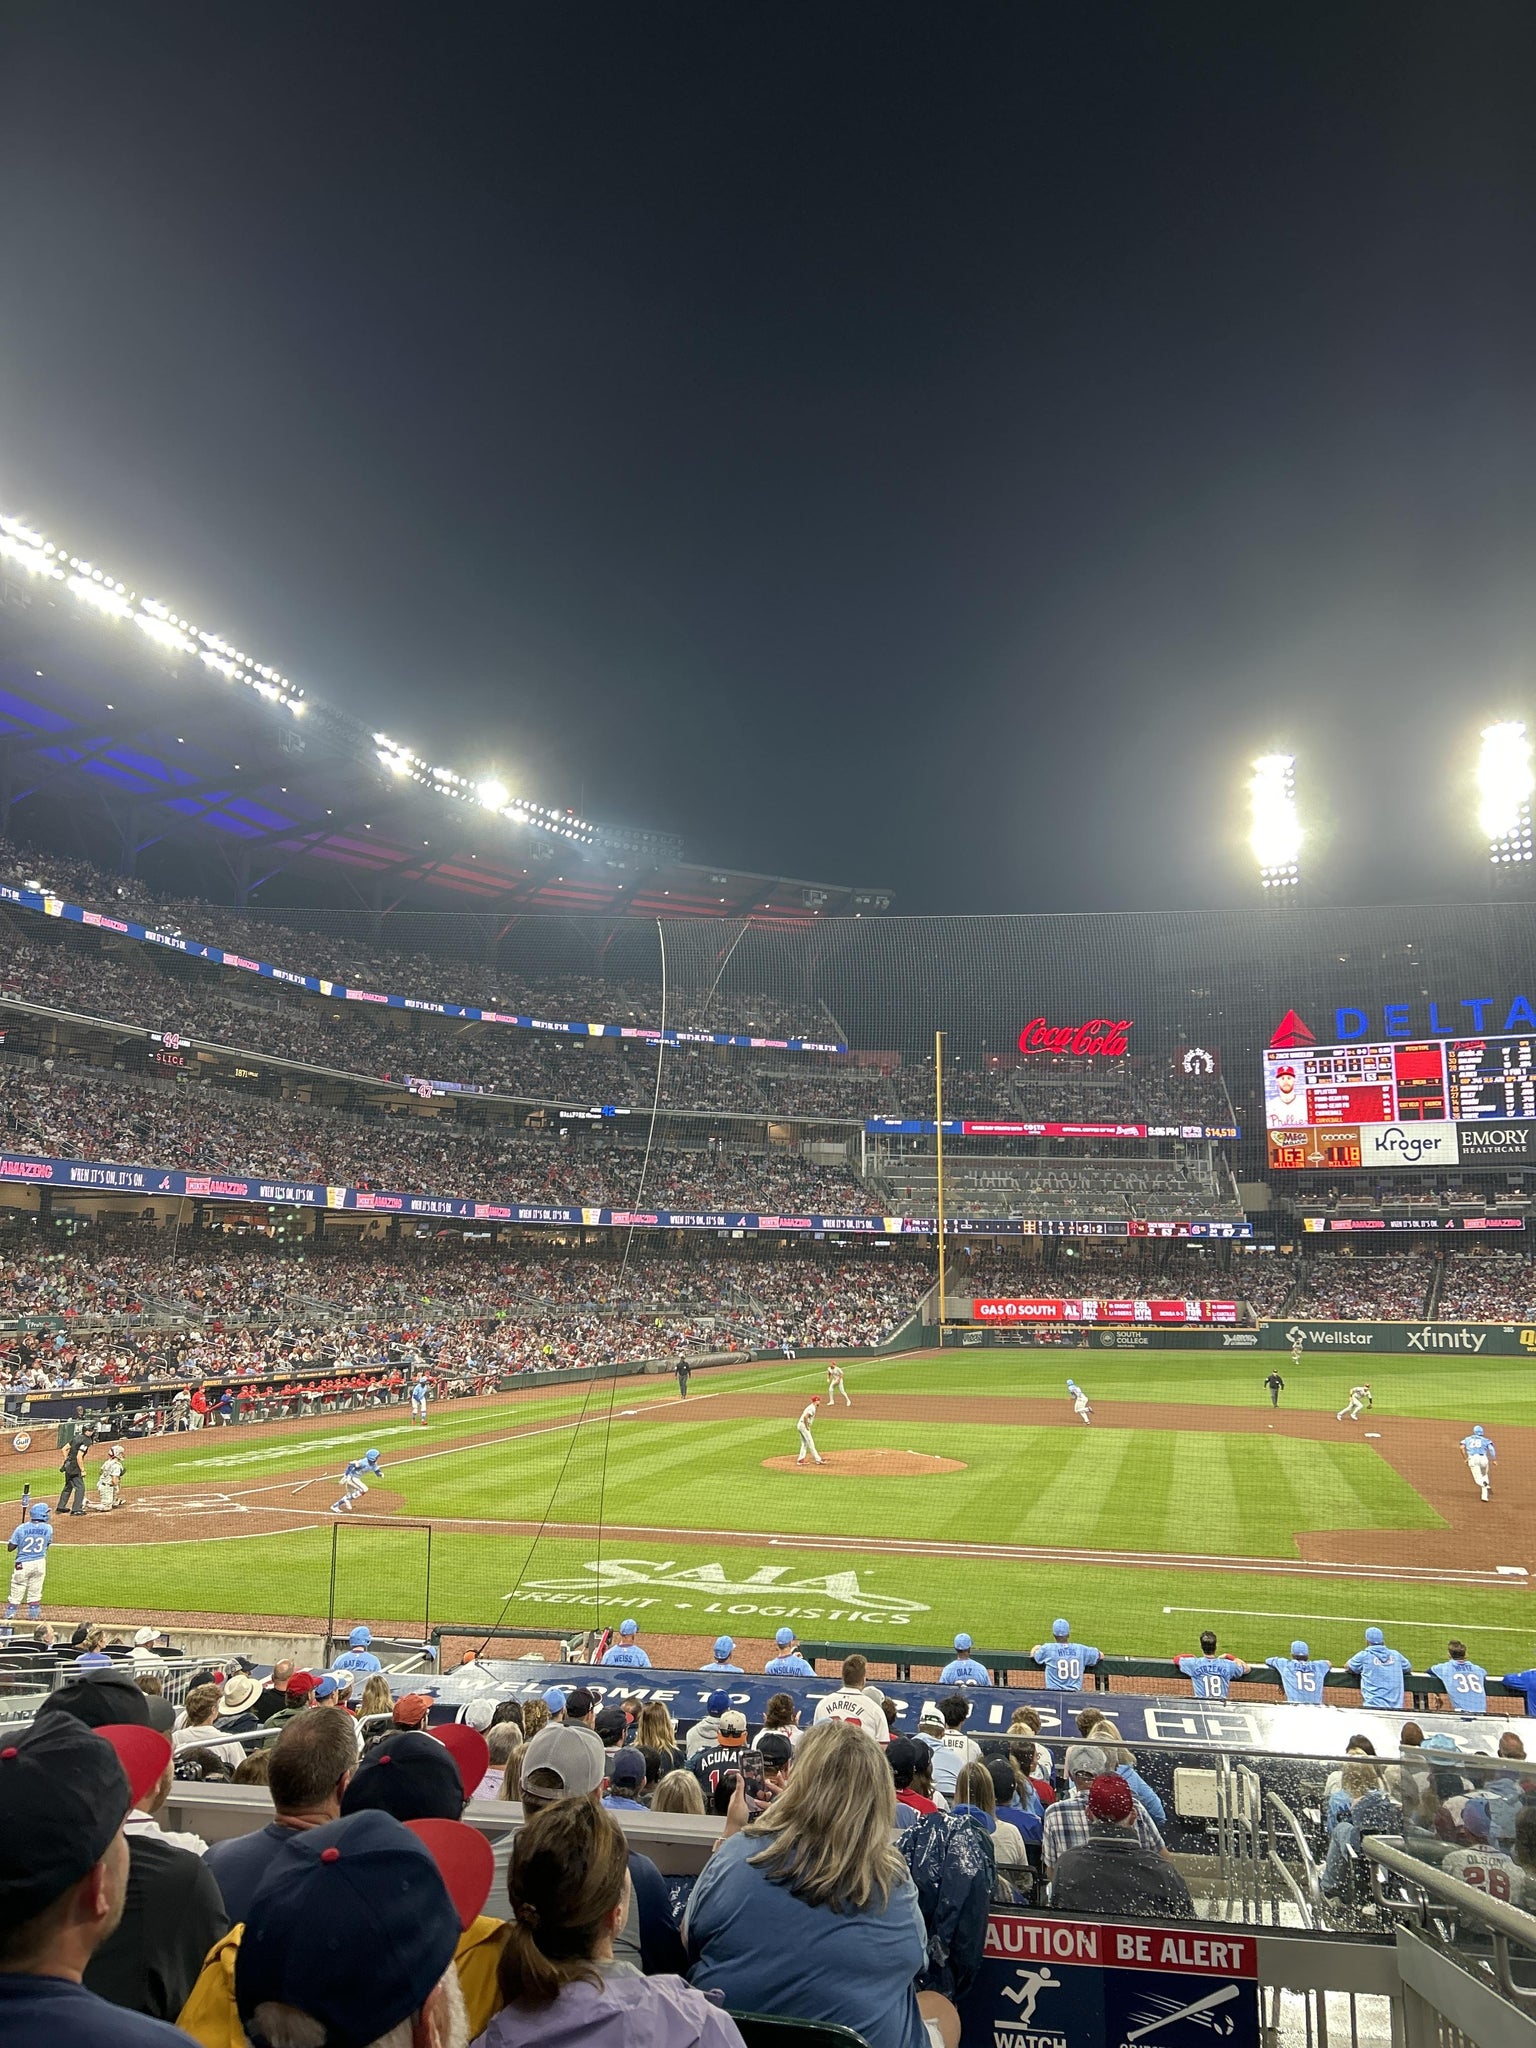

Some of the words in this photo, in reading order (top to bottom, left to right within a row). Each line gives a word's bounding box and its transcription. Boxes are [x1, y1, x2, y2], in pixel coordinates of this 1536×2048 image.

[1335, 994, 1536, 1040] DELTA
[163, 1032, 180, 1050] 44
[1018, 1016, 1133, 1056] Coca-Cola
[156, 1053, 184, 1066] SLICE
[418, 1085, 433, 1098] 47
[602, 1106, 616, 1116] 42
[1166, 1127, 1179, 1136] PM
[1461, 1129, 1530, 1146] EMORY
[1375, 1128, 1442, 1162] Kroger
[1462, 1145, 1528, 1154] HEALTHCARE
[1278, 1148, 1305, 1162] 163
[1334, 1146, 1360, 1160] 118
[1, 1160, 54, 1178] AMAZING
[70, 1168, 90, 1182] WHEN
[90, 1170, 104, 1184] IT'S
[106, 1170, 118, 1186] ON,
[119, 1172, 133, 1186] IT'S
[134, 1173, 144, 1187] ON.
[968, 1170, 1020, 1190] HANK
[1024, 1171, 1091, 1191] AARON
[1093, 1172, 1185, 1191] TERRACE
[210, 1181, 248, 1196] AMAZING
[518, 1209, 532, 1219] WHEN
[532, 1210, 544, 1220] IT'S
[552, 1210, 562, 1220] IT'S
[670, 1215, 684, 1224] WHEN
[684, 1216, 696, 1225] IT'S
[706, 1216, 716, 1225] IT'S
[779, 1218, 812, 1228] AMAZING
[822, 1218, 836, 1228] WHEN
[836, 1219, 846, 1229] IT'S
[856, 1220, 865, 1229] IT'S
[1351, 1220, 1386, 1228] AMAZING
[1486, 1218, 1522, 1228] AMAZING
[980, 1304, 1004, 1316] GAS
[1018, 1304, 1056, 1316] SOUTH
[1064, 1306, 1080, 1316] AL
[1309, 1331, 1374, 1345] Wellstar
[1406, 1326, 1486, 1352] xfinity
[22, 1536, 44, 1552] 23
[500, 1590, 664, 1608] FREIGHT
[704, 1601, 912, 1624] LOGISTICS
[614, 1654, 632, 1663] WEISS
[1057, 1658, 1080, 1680] 80
[1202, 1675, 1222, 1697] 18
[1295, 1671, 1316, 1692] 15
[1452, 1673, 1484, 1694] 36
[826, 1700, 857, 1716] HARRIS
[943, 1738, 964, 1749] LBIES
[701, 1748, 737, 1770] ACUÑA
[1466, 1854, 1504, 1866] OLSON
[1463, 1866, 1510, 1902] 28
[984, 1923, 1098, 1958] AUTION
[1116, 1934, 1152, 1962] BE
[1160, 1938, 1245, 1969] ALERT
[993, 2032, 1067, 2048] WATCH
